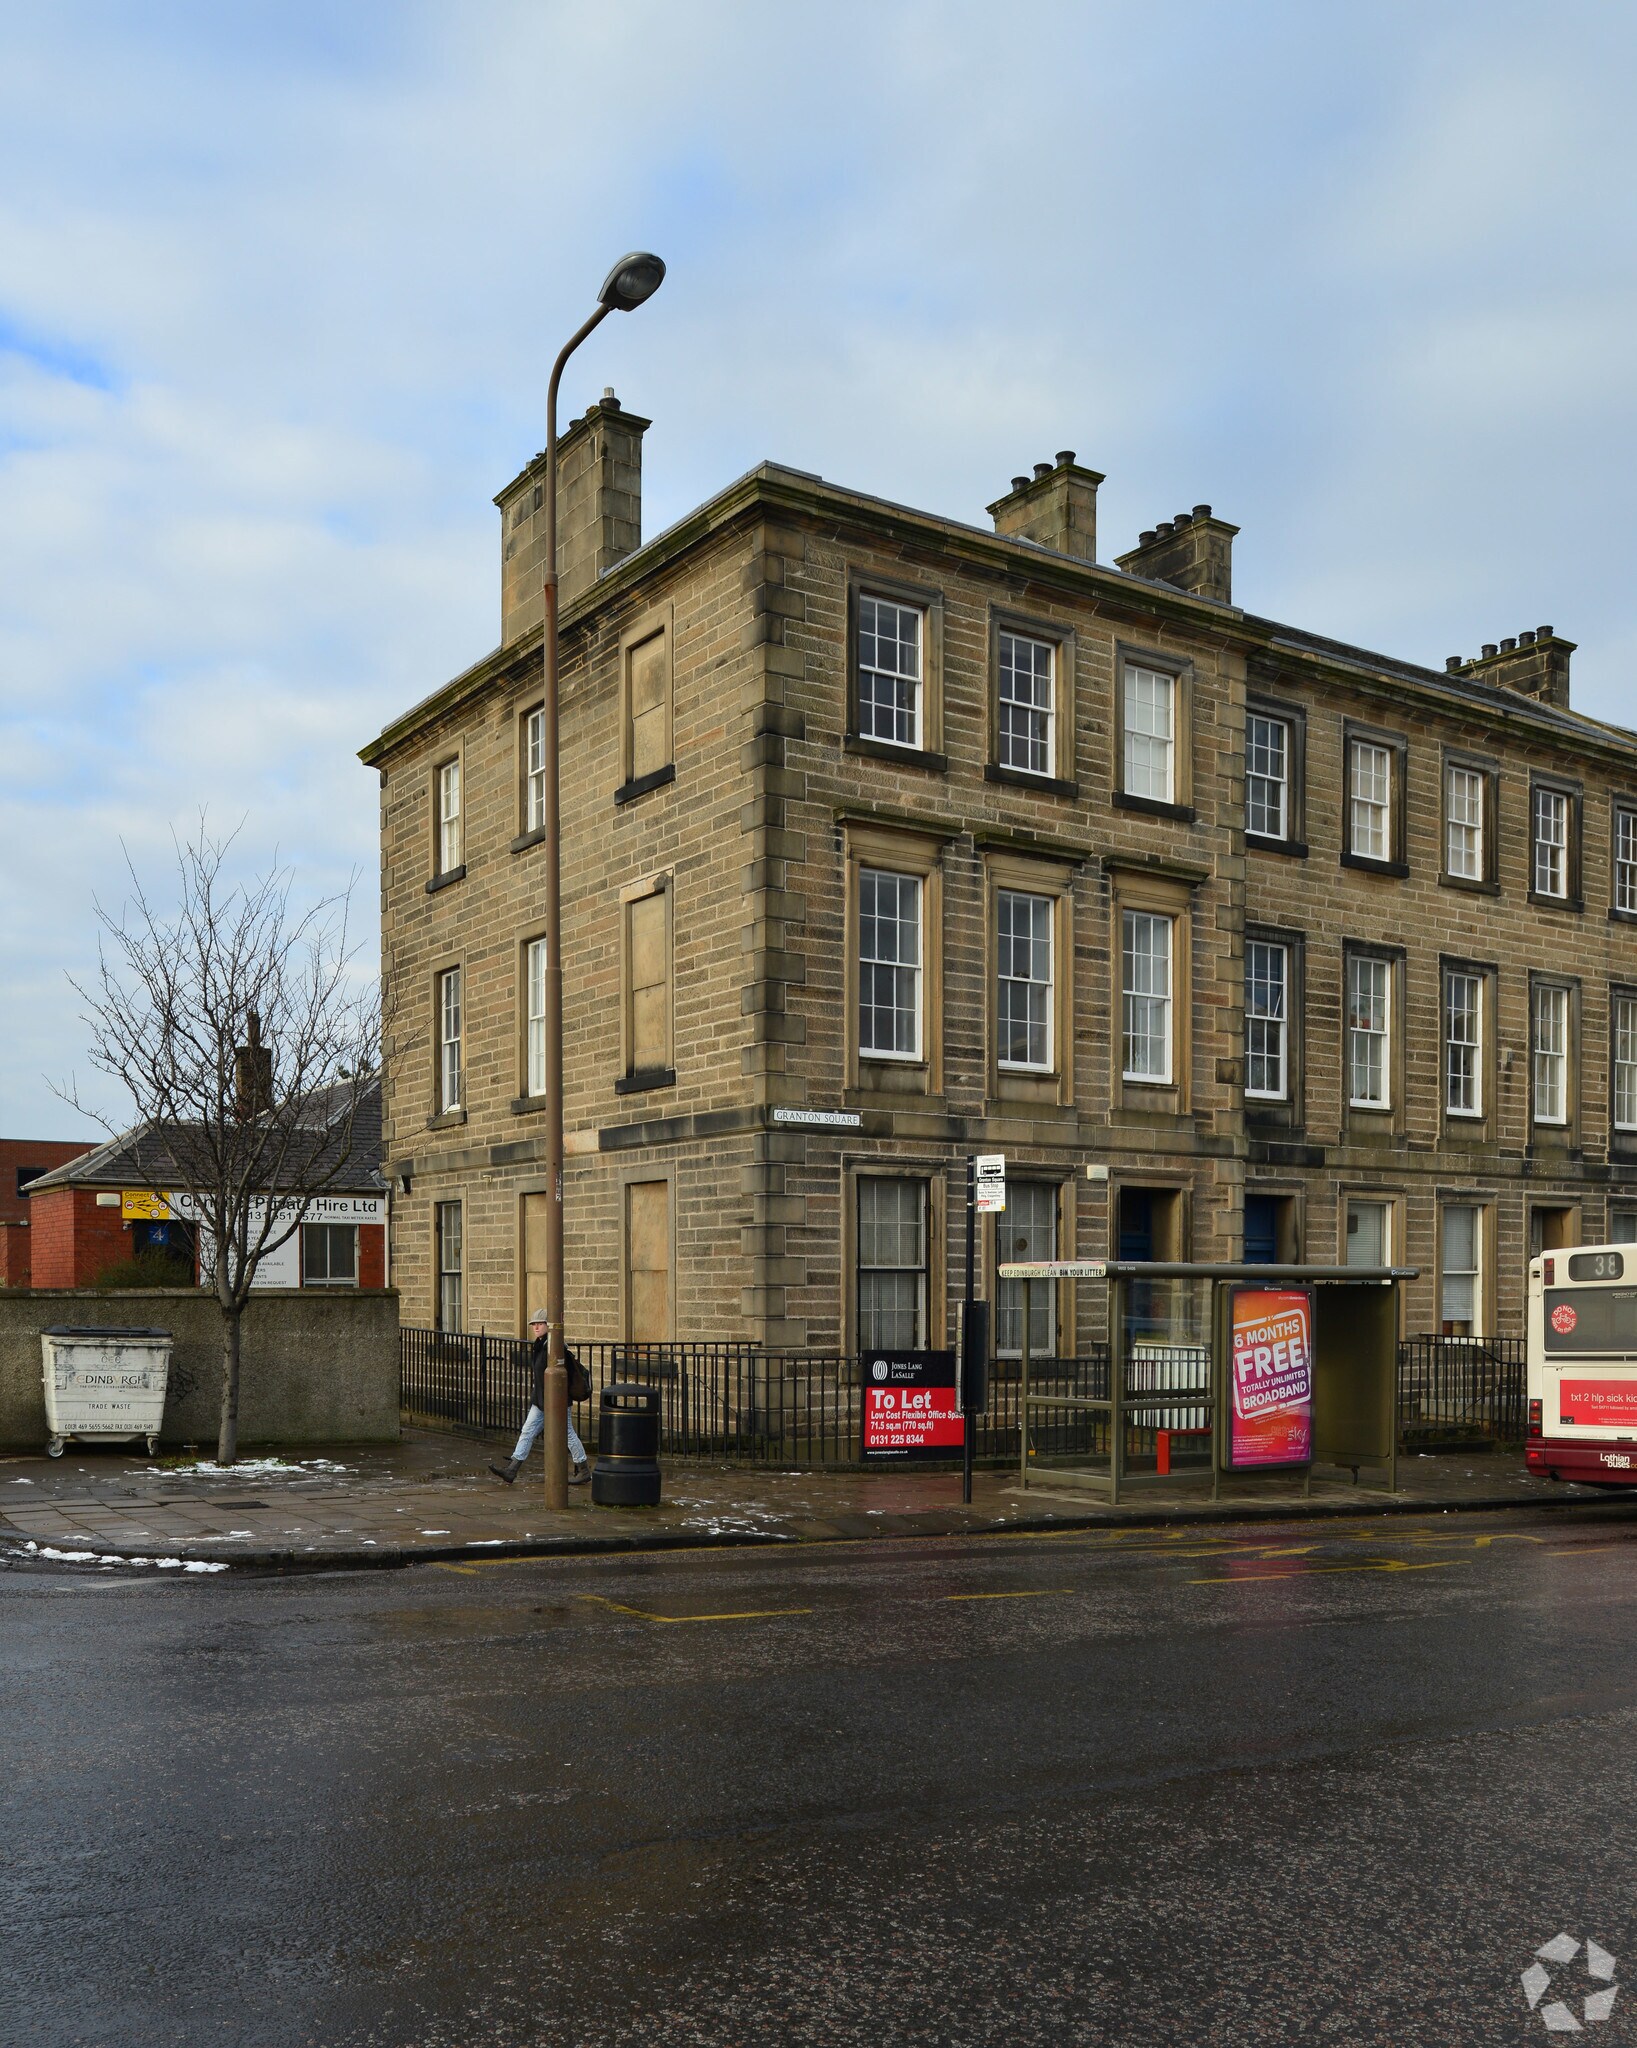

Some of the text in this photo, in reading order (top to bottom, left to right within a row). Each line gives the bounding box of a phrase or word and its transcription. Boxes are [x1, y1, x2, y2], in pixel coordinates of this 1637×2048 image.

[776, 1111, 858, 1125] GRANTON SQUARE
[317, 1199, 348, 1212] Hire
[353, 1200, 377, 1213] Ltd
[152, 1227, 165, 1241] 4
[1595, 1254, 1616, 1276] 38
[1001, 1269, 1013, 1277] KEEP
[1013, 1269, 1041, 1277] EDINBURGH
[1041, 1269, 1057, 1277] CLEAN
[1060, 1269, 1069, 1277] BIN
[1553, 1305, 1576, 1316] DO NOT
[1234, 1318, 1300, 1348] 6 MONTHS
[1234, 1336, 1304, 1383] FREE
[1241, 1369, 1306, 1394] TOTALLY UNLIMITED
[871, 1389, 931, 1408] To Let
[1242, 1381, 1307, 1409] BROADBAND
[1570, 1393, 1582, 1402] txt
[1583, 1393, 1589, 1402] 2
[1591, 1393, 1605, 1403] hlp
[1606, 1393, 1624, 1402] sick
[871, 1411, 884, 1420] Low
[886, 1410, 901, 1419] Cost
[901, 1410, 926, 1419] Flexible
[928, 1410, 946, 1419] Office
[870, 1421, 934, 1431] 71.5 sq.m (770 sq.ft)
[870, 1434, 924, 1444] 0131 225 8344
[1600, 1453, 1630, 1462] Lothian
